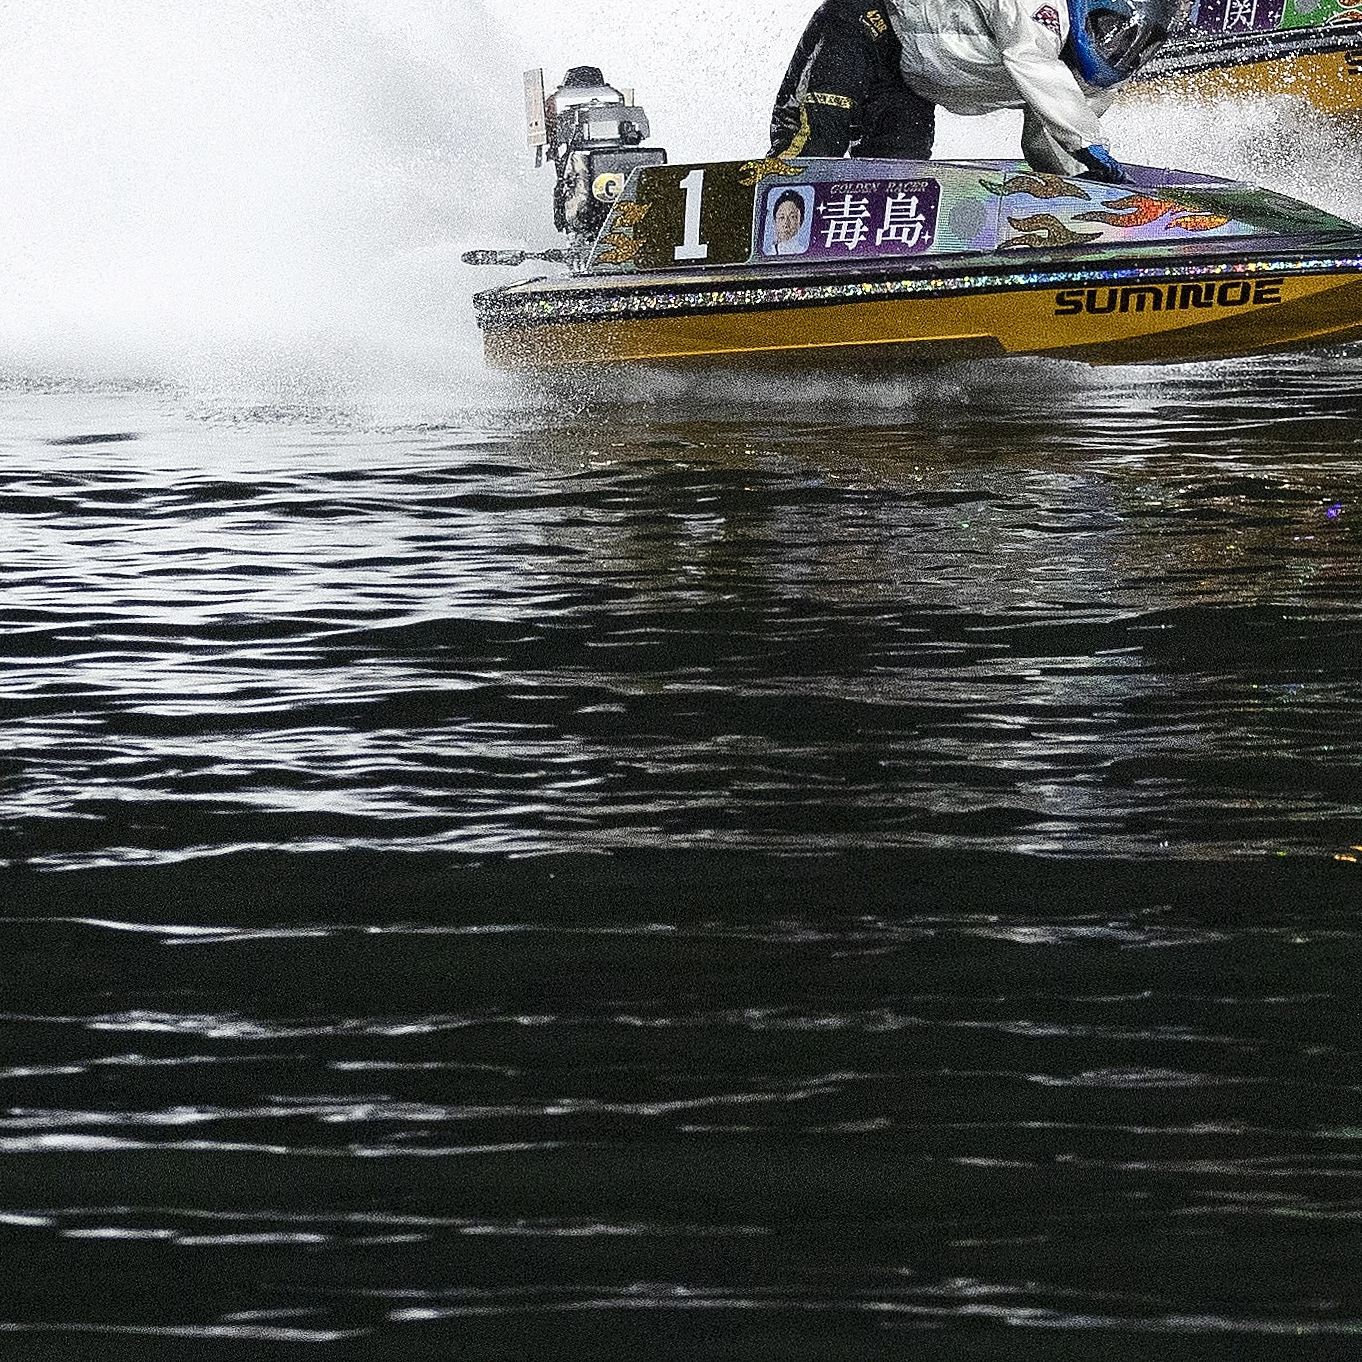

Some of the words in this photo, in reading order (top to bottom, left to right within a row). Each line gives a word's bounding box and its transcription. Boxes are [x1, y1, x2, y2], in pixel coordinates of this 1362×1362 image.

[830, 182, 881, 194] GOLDEN
[886, 181, 929, 193] RACER
[674, 169, 708, 260] 1
[821, 192, 926, 251] 毒島
[1054, 278, 1284, 316] SUMINOE
